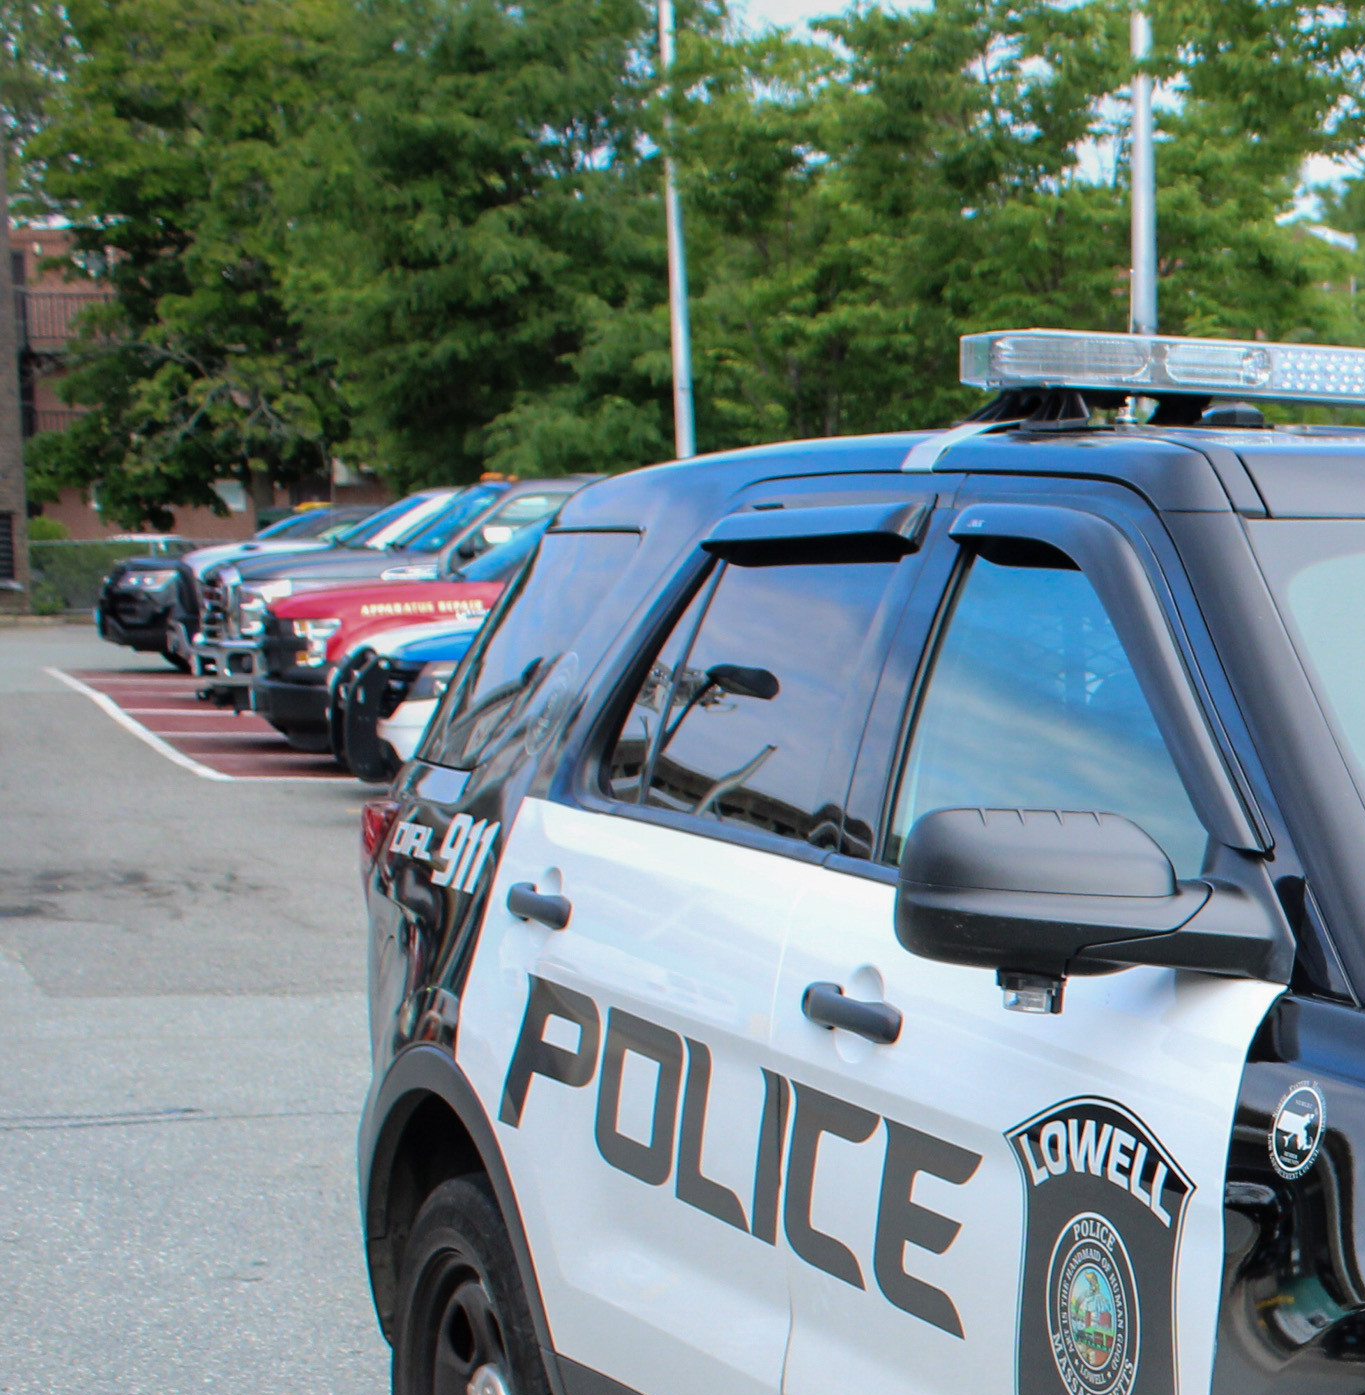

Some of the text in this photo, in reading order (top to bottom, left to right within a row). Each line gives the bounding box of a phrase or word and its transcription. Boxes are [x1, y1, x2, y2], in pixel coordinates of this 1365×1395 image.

[389, 812, 501, 895] DIAL 911
[498, 972, 984, 1341] POLICE
[1018, 1118, 1172, 1229] LOWELL
[1073, 1220, 1116, 1252] POLICE
[1080, 1364, 1107, 1385] LOWELL
